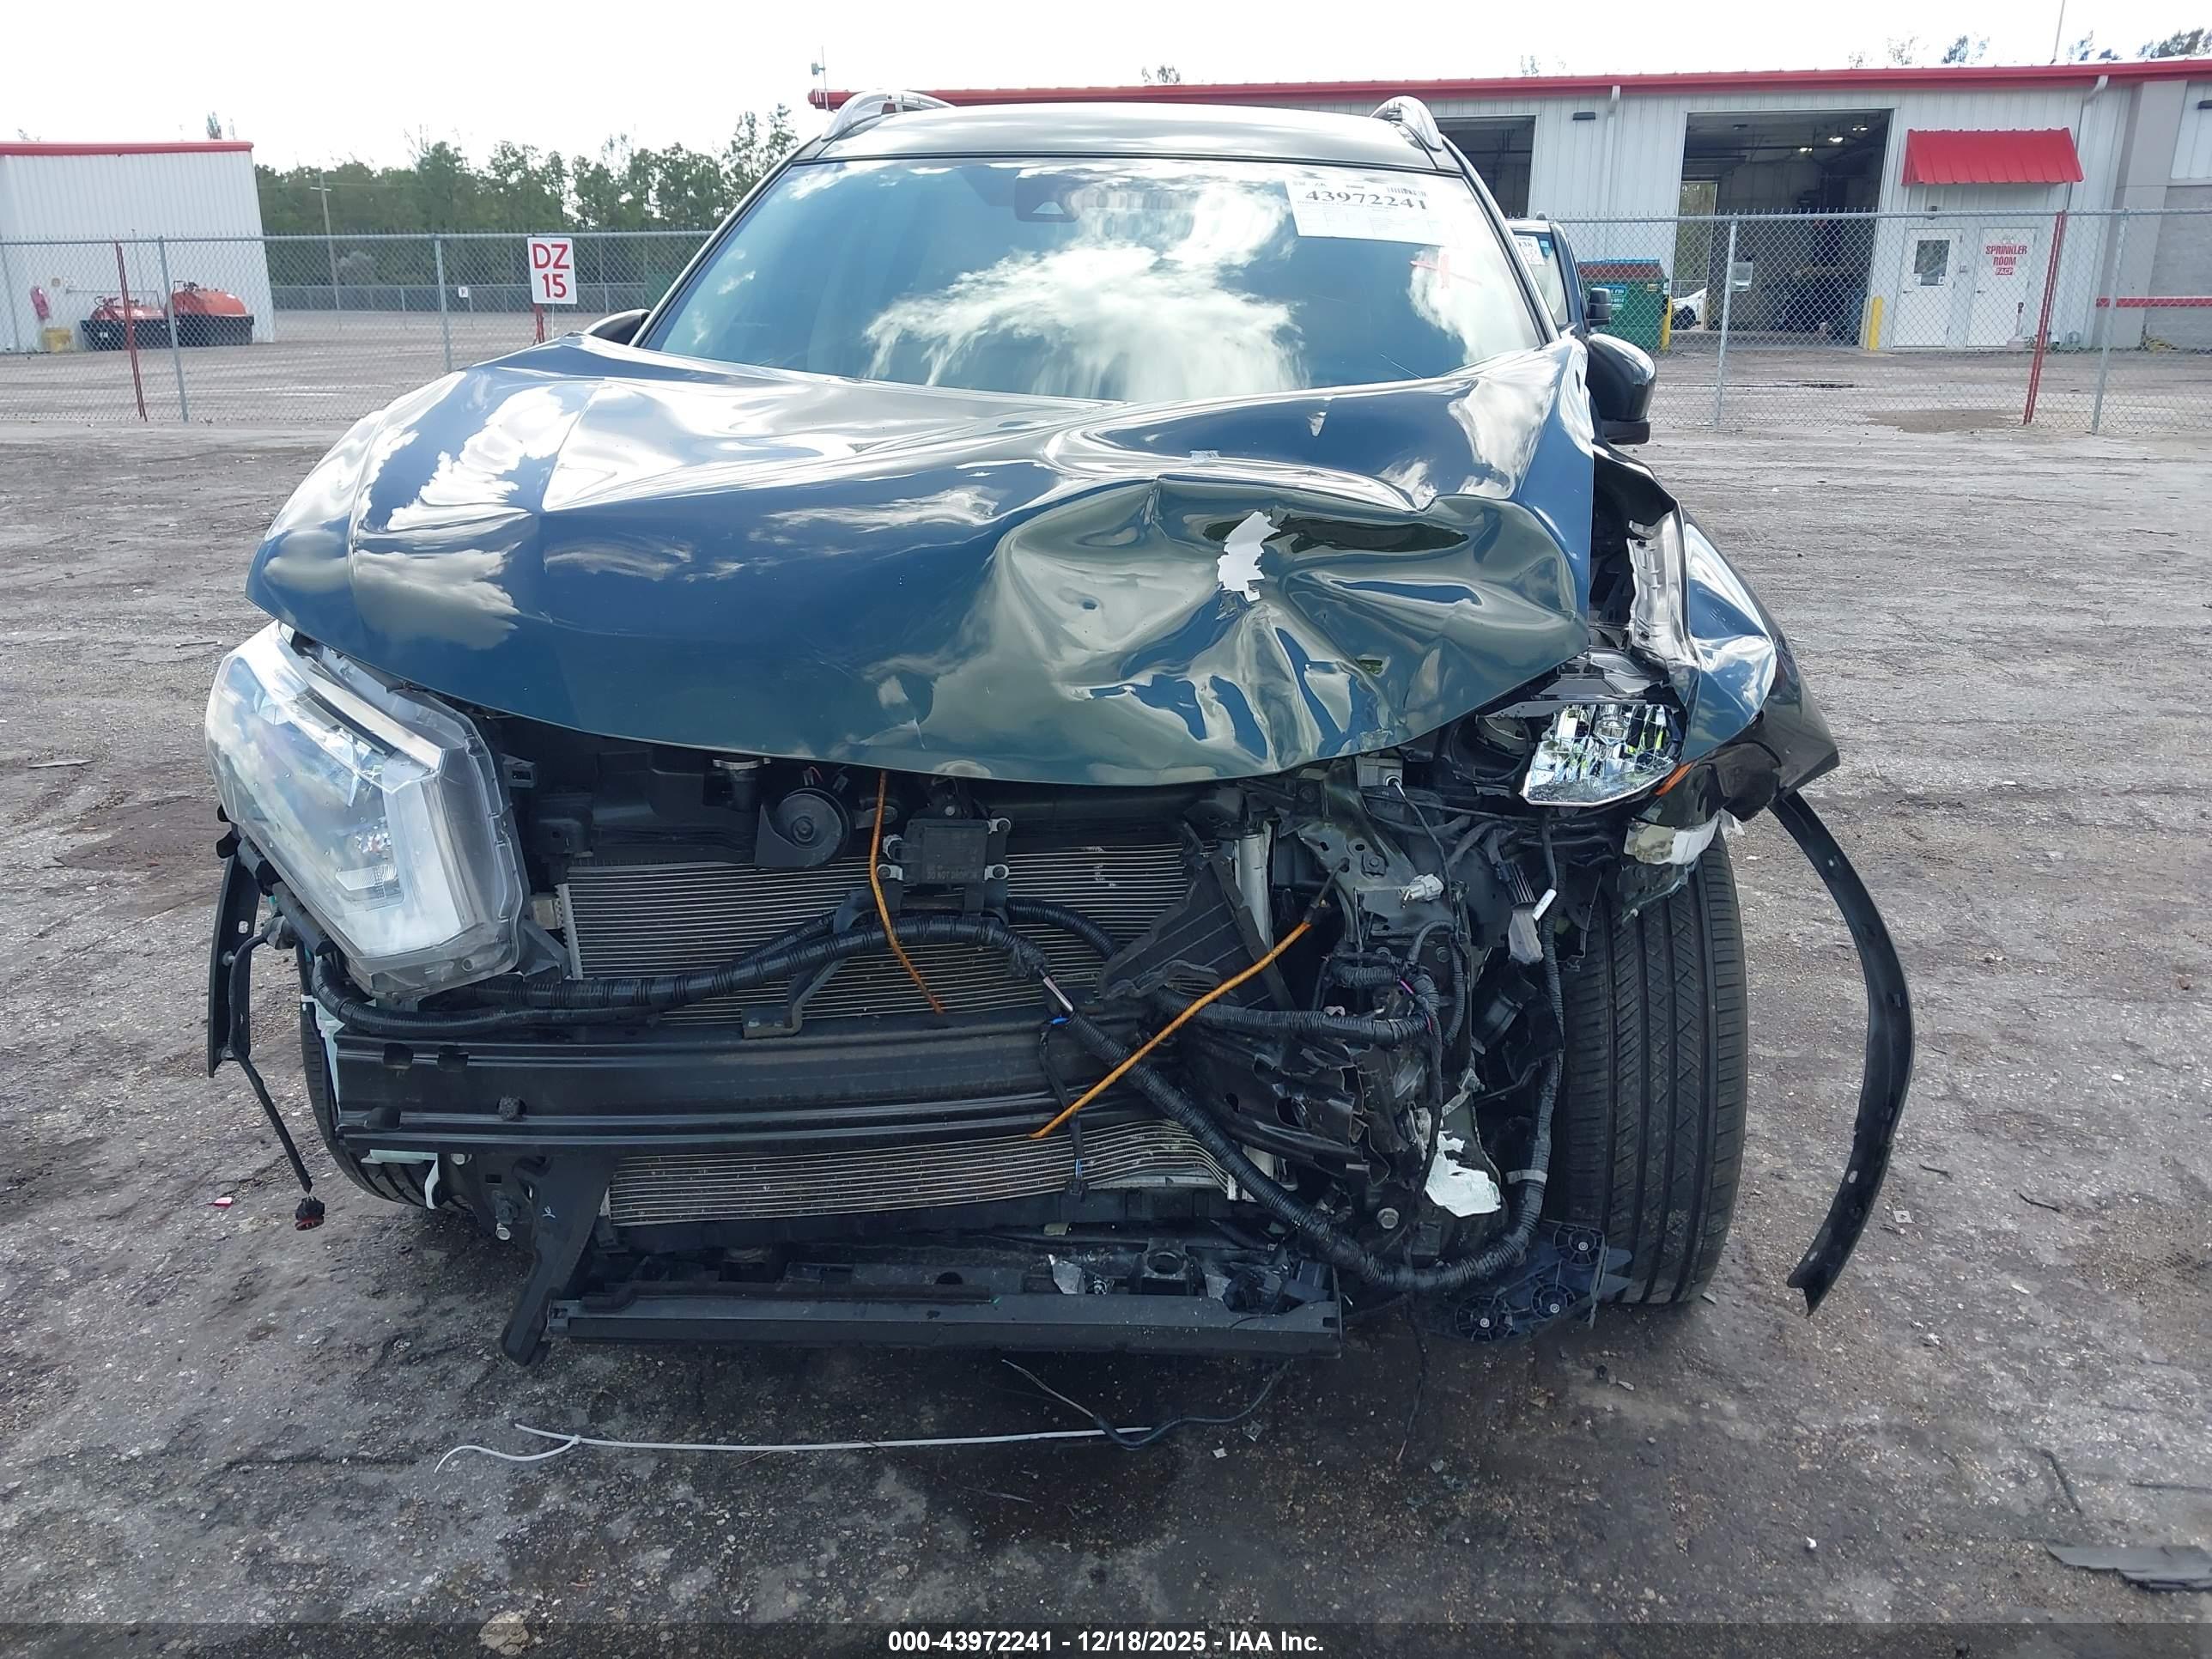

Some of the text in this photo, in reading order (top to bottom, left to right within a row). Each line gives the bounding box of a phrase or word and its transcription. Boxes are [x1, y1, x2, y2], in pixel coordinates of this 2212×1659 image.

[1304, 190, 1428, 210] 43972241
[532, 243, 570, 269] DZ
[1985, 246, 2027, 255] SPRINKLER
[1993, 257, 2016, 265] ROOM
[542, 273, 567, 298] 15
